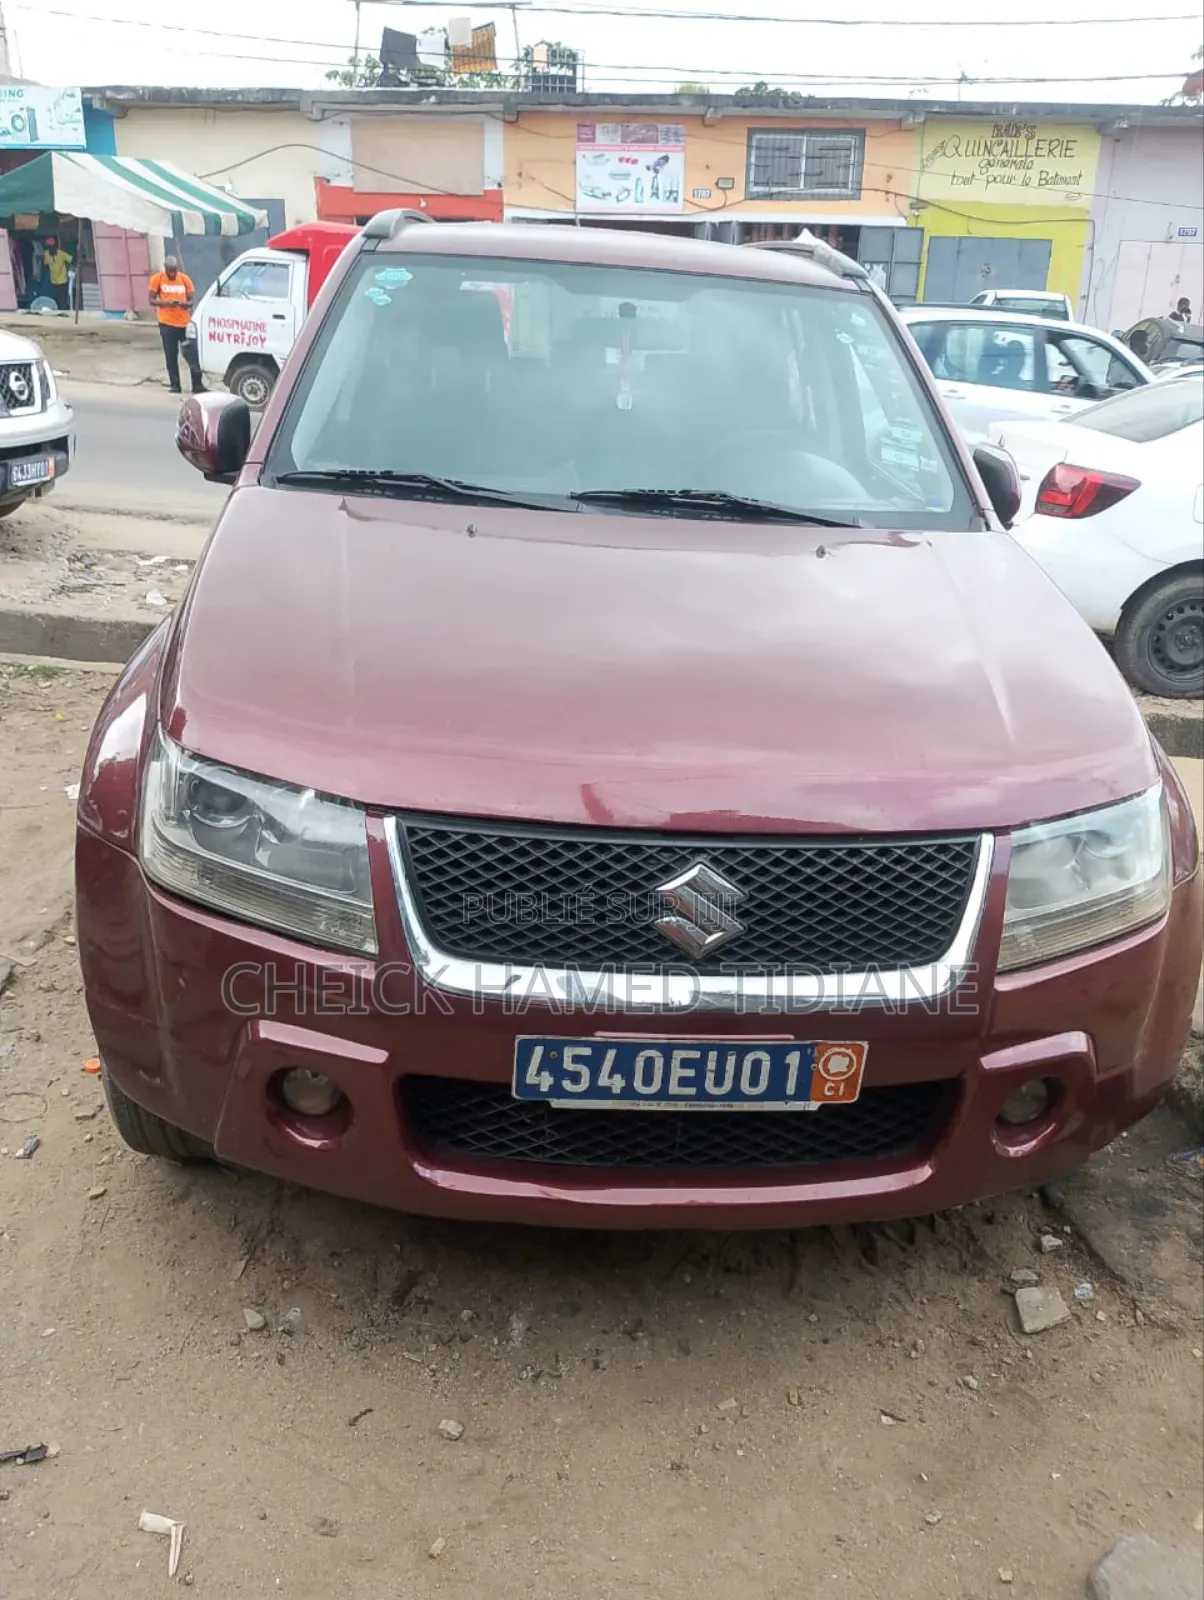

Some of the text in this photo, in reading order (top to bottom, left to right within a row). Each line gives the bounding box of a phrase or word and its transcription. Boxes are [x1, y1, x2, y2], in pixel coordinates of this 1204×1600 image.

[943, 135, 1078, 159] QUINCAILLERIE
[951, 170, 976, 186] tout
[985, 173, 1017, 192] pour
